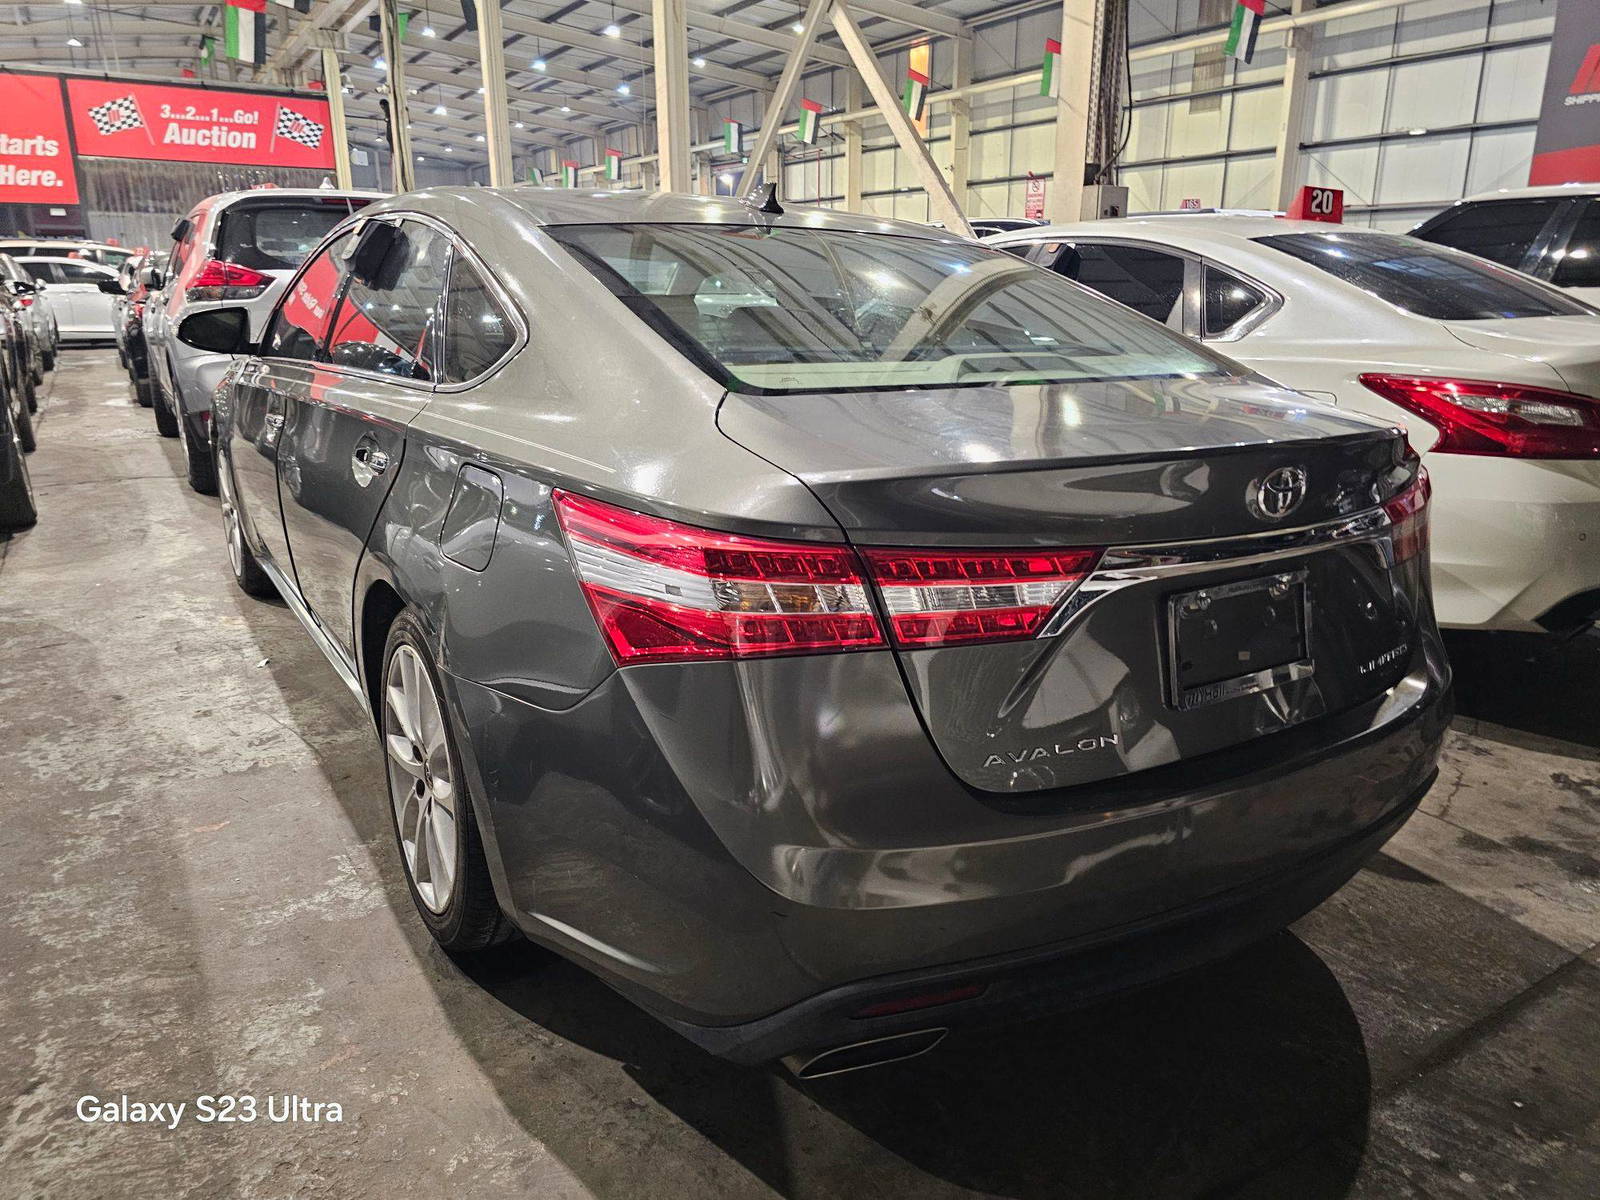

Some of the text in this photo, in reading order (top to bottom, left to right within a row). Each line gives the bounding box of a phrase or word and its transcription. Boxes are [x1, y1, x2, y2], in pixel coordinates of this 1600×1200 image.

[163, 122, 256, 149] Auction
[0, 164, 63, 187] Here.
[1311, 189, 1333, 214] 20
[983, 734, 1119, 768] AVALON
